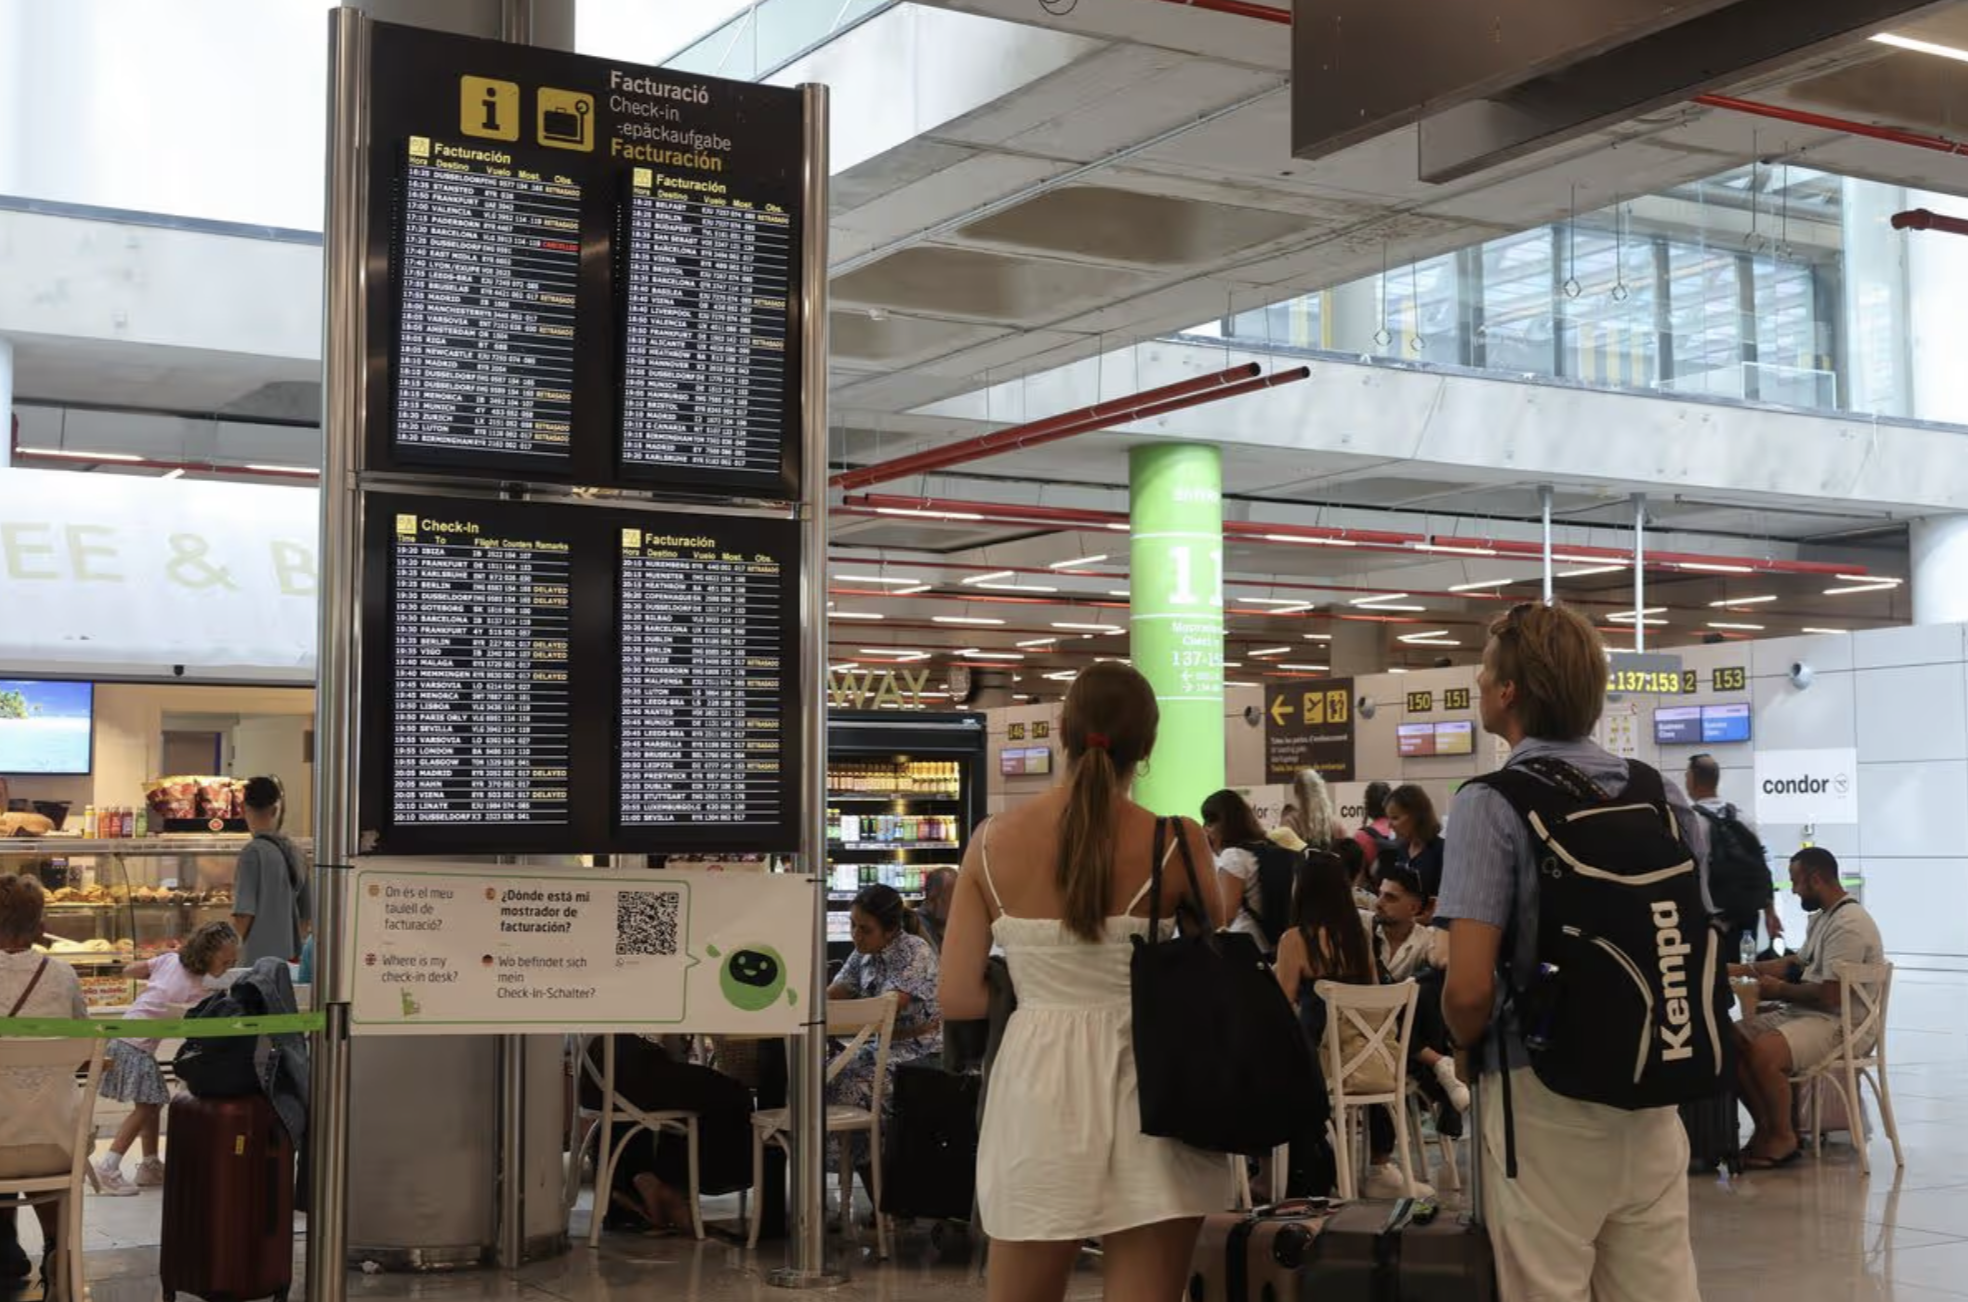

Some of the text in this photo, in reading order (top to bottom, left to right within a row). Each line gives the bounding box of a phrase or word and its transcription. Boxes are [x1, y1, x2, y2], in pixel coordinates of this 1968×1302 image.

[610, 70, 708, 104] Facturació
[610, 96, 680, 122] Check-in
[617, 122, 732, 152] epäckaufgabe
[434, 142, 511, 164] Facturación
[612, 138, 722, 172] Facturación
[436, 159, 469, 171] Destino
[486, 166, 511, 176] Vuelo
[656, 174, 726, 193] Facturación
[657, 190, 687, 201] Destino
[703, 196, 726, 205] Vuelo
[431, 205, 471, 215] VALENCIA
[653, 244, 696, 254] BARCELONA
[427, 293, 460, 302] MADRID
[426, 315, 468, 325] VARSOVIA
[650, 318, 687, 327] VALENCIA
[425, 325, 475, 336] AMSTERDAM
[424, 347, 473, 358] NEWCASTLE
[424, 358, 457, 367] MADRID
[422, 402, 456, 410] MUNICH
[421, 424, 449, 432] LUTON
[421, 518, 479, 533] Check-In
[474, 538, 499, 547] Flight
[534, 541, 568, 550] Remarks
[645, 533, 714, 547] Facturación
[421, 547, 445, 555] IBIZA
[647, 549, 677, 557] Destino
[693, 551, 715, 559] Vuelo
[1, 522, 318, 596] EE & B
[421, 559, 468, 567] FRANKFURT
[420, 581, 451, 589] BERLIN
[1714, 669, 1742, 688] 153
[828, 667, 930, 711] WAY
[1408, 693, 1430, 711] 150
[1446, 690, 1468, 708] 151
[1763, 774, 1830, 794] condor
[385, 886, 454, 900] On és el meu
[501, 889, 590, 902] ¿Dónde está mi
[385, 903, 434, 915] taulell de
[501, 906, 578, 918] mostrador de
[385, 919, 442, 931] facturació?
[500, 922, 571, 934] facturación?
[382, 954, 446, 969] Where is my
[498, 956, 586, 968] Wo befindet sich
[382, 970, 458, 983] check-in desk?
[498, 972, 524, 983] mein
[1650, 900, 1692, 1062] Kempa
